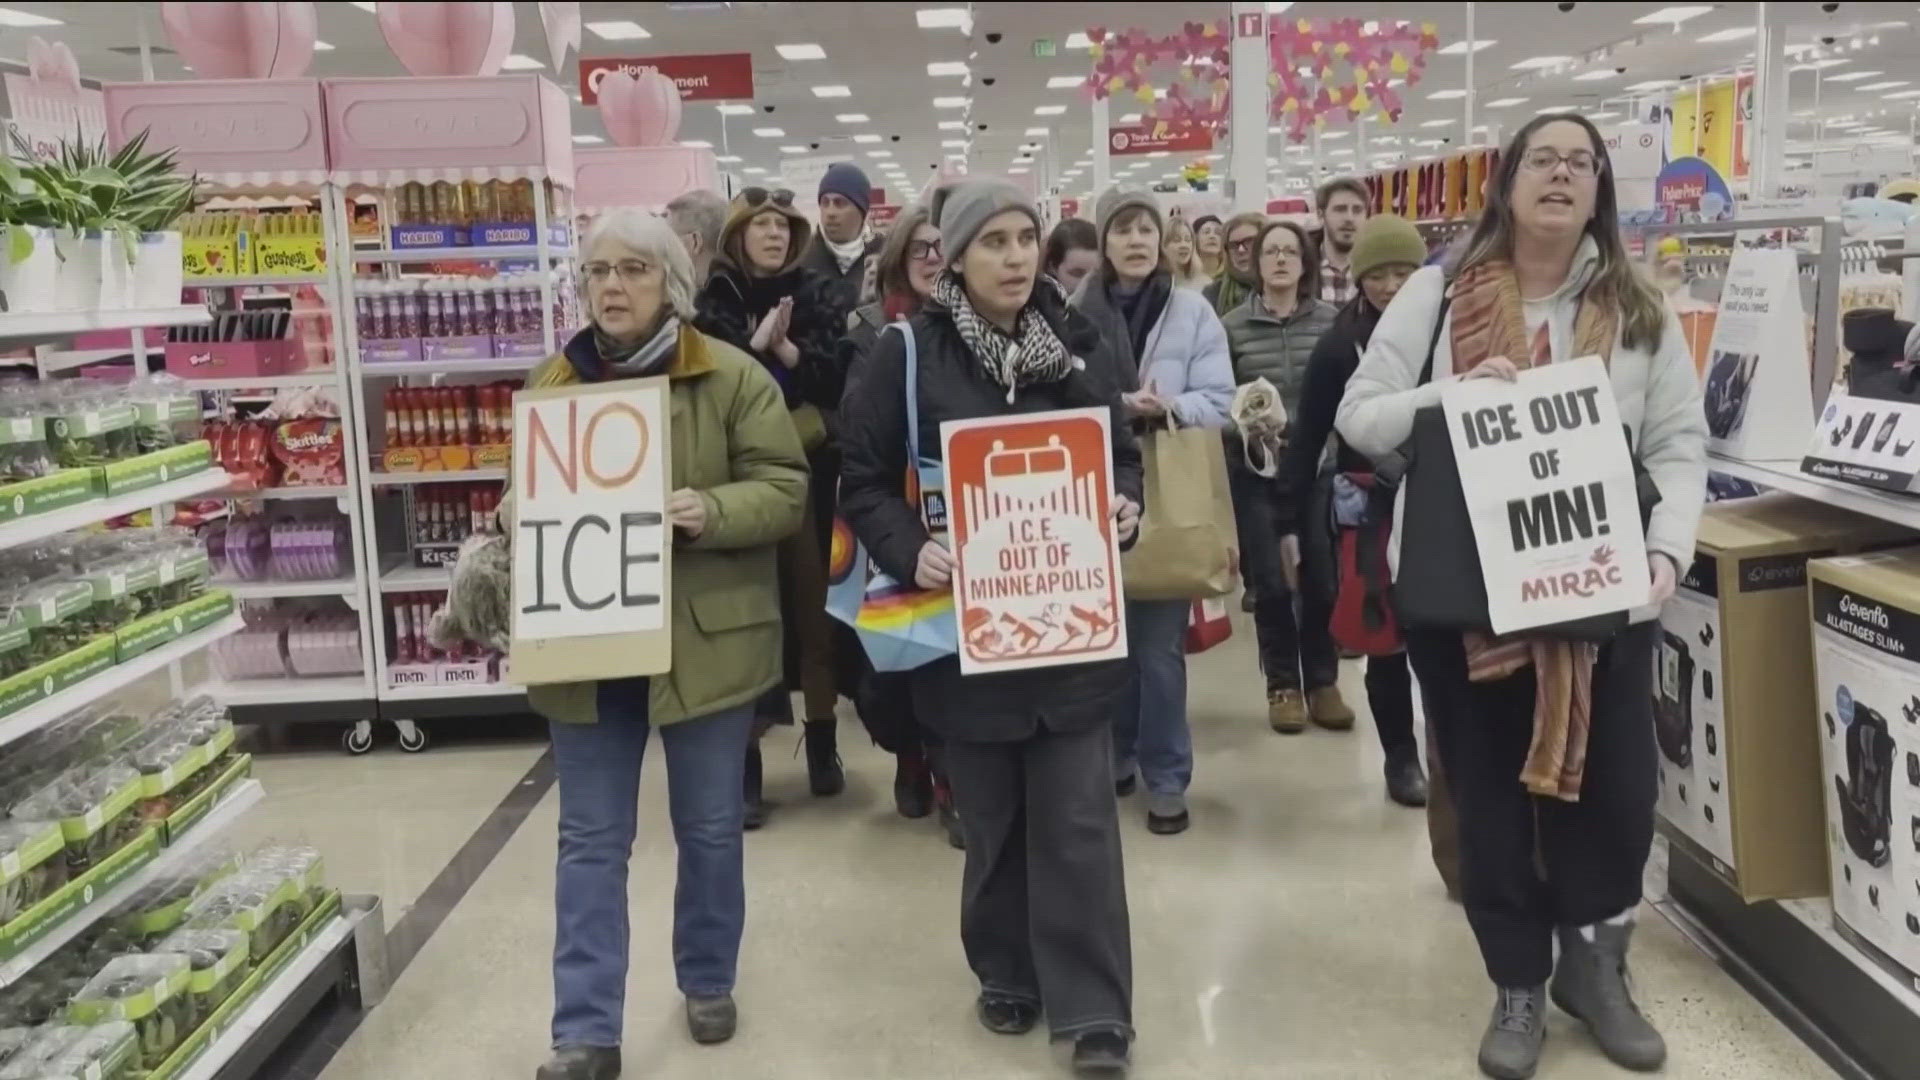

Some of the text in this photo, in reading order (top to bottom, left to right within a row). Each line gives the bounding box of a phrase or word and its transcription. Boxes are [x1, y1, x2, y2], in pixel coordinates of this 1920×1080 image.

[400, 231, 444, 244] HARIBO
[485, 229, 530, 242] HARIBO
[264, 250, 307, 269] Gushers
[1461, 386, 1601, 450] ICE OUT
[285, 432, 334, 450] Skittles
[527, 399, 650, 499] NO
[1529, 448, 1560, 480] OF
[1009, 518, 1059, 545] I.C.E.
[1506, 481, 1611, 553] MN!
[521, 511, 662, 614] ICE
[999, 542, 1072, 572] OUT OF
[971, 567, 1105, 601] MINNEAPOLIS
[1521, 566, 1622, 603] MIRAC
[1849, 603, 1889, 629] evenflo
[1876, 631, 1905, 652] SLIM+
